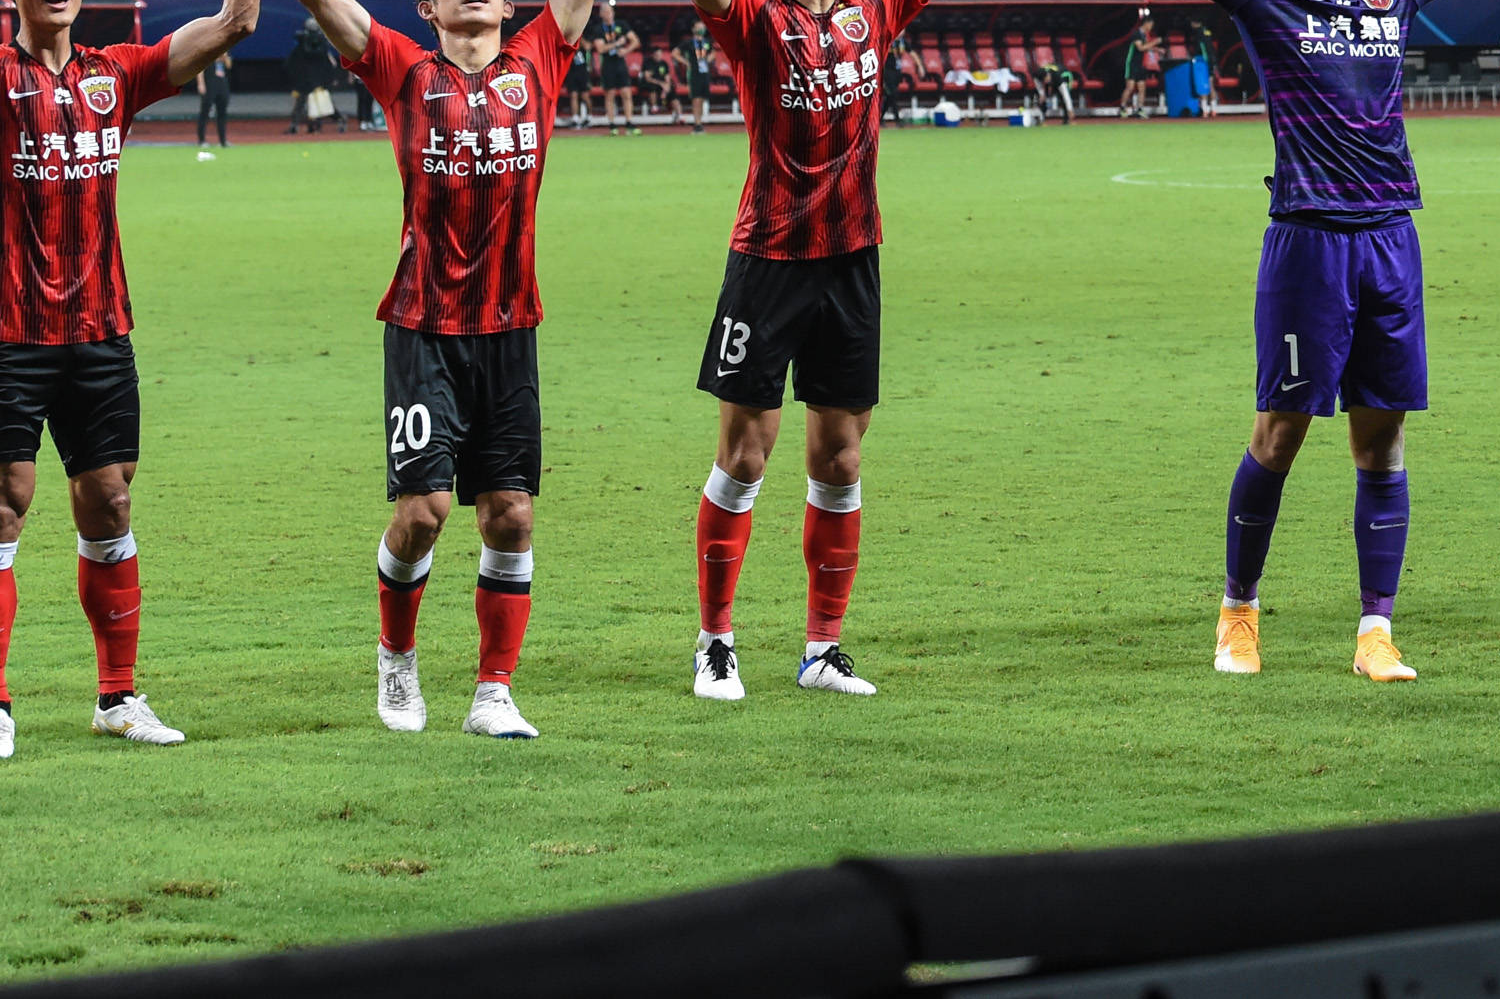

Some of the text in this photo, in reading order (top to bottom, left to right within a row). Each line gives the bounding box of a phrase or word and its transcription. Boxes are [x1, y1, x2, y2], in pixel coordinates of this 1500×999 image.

[1299, 14, 1400, 41] 上汽集团
[1300, 41, 1401, 57] SAIC MOTOR
[780, 48, 879, 93] 上汽集团
[780, 94, 824, 111] SAIC
[11, 127, 121, 161] 上汽集团
[422, 122, 537, 157] 上汽集团
[12, 159, 120, 181] SAIC MOTOR
[423, 154, 537, 176] SAIC MOTOR
[719, 316, 751, 364] 13
[1284, 333, 1299, 377] 1
[390, 403, 431, 454] 20
